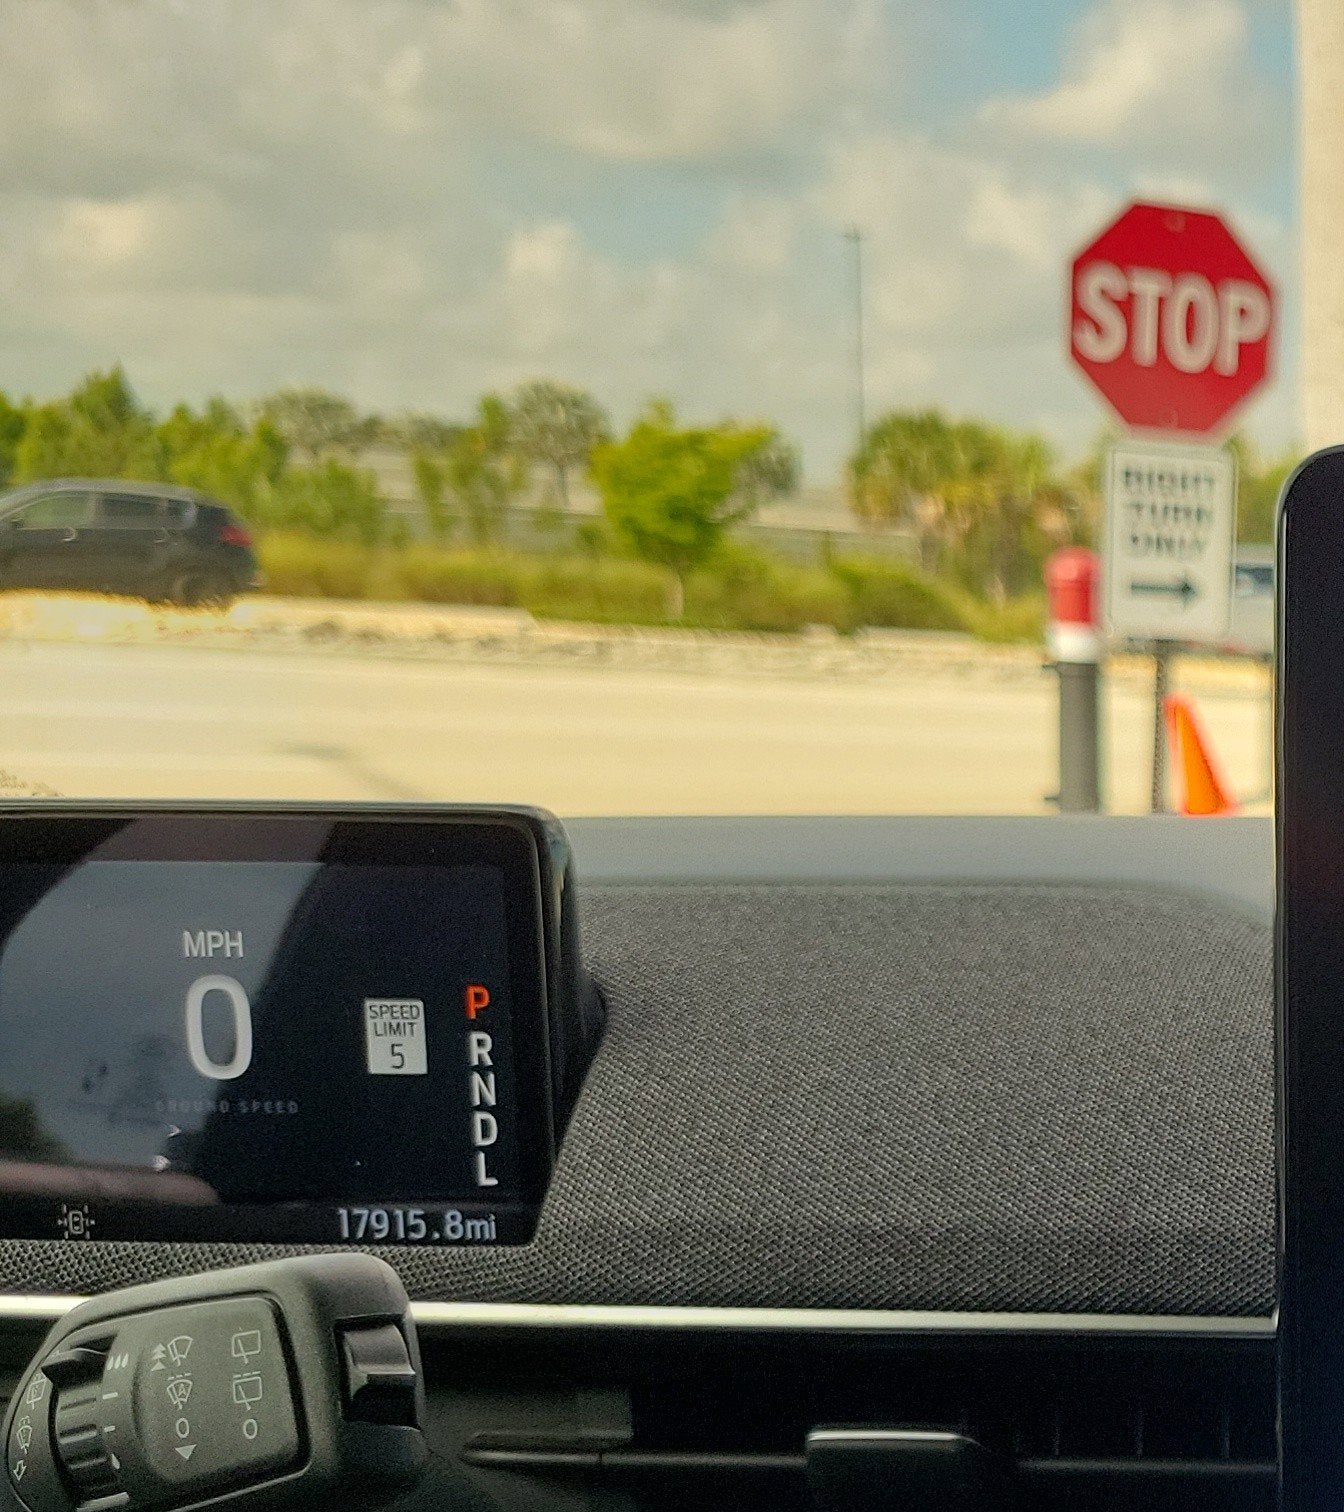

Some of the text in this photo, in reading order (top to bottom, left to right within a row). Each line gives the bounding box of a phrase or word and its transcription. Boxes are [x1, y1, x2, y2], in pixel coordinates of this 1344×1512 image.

[1074, 261, 1272, 376] STOP
[183, 931, 243, 958] MPH
[368, 1003, 421, 1022] SPEED
[466, 985, 490, 1019] P
[186, 974, 253, 1080] 0
[373, 1021, 418, 1038] LIMIT
[389, 1043, 406, 1070] 5
[470, 1031, 493, 1066] R
[471, 1073, 496, 1106] N
[474, 1112, 498, 1146] D
[477, 1151, 499, 1186] L
